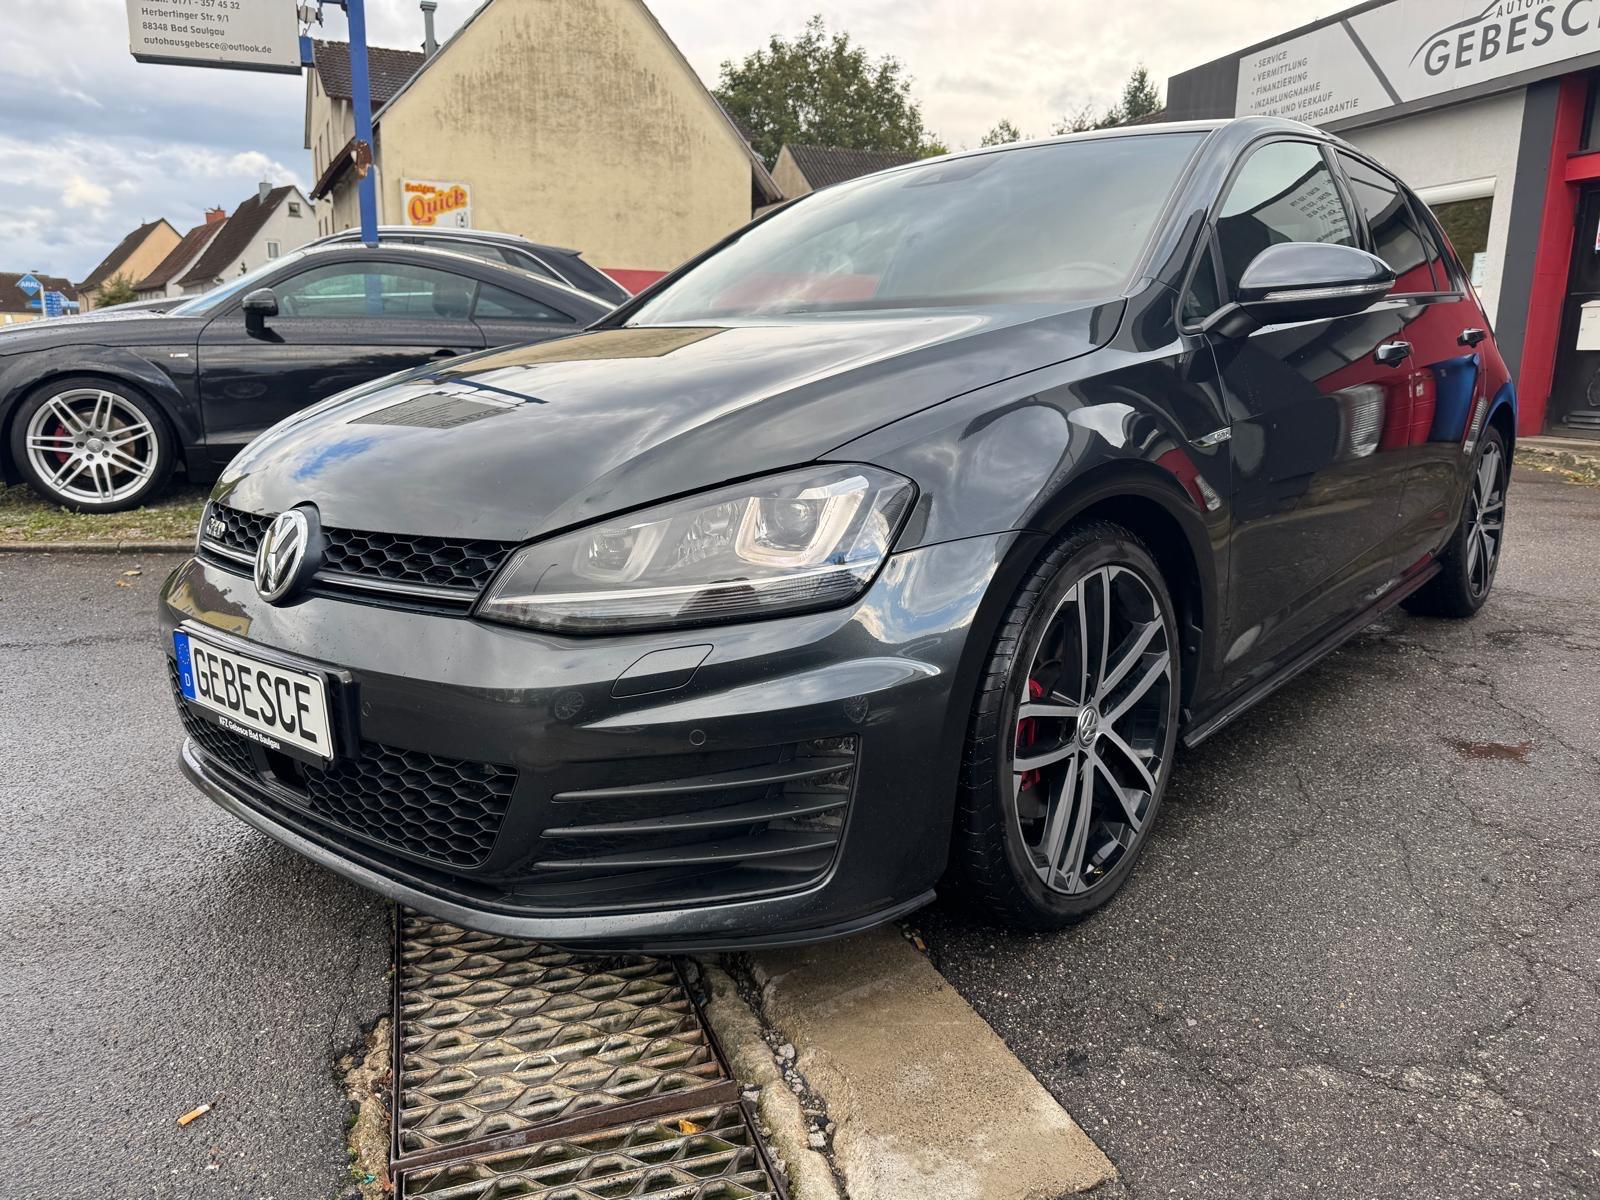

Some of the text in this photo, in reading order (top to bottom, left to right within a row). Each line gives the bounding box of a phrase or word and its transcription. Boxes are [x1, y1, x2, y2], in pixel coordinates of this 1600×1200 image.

[201, 0, 214, 8] 357
[217, 1, 228, 9] 45
[230, 1, 240, 10] 32
[141, 7, 229, 23] Herbertinger Str. 9/1
[142, 22, 225, 36] 88348 Bad Saulgau
[1424, 0, 1600, 76] GEBESC
[143, 36, 272, 54] autohausgebesce@outlook.de
[1298, 91, 1333, 109] VERKAUF
[409, 187, 466, 225] Quick
[184, 673, 192, 687] D
[193, 647, 318, 744] GEBESCE
[248, 729, 259, 742] Bad
[258, 732, 281, 750] Saulgau
